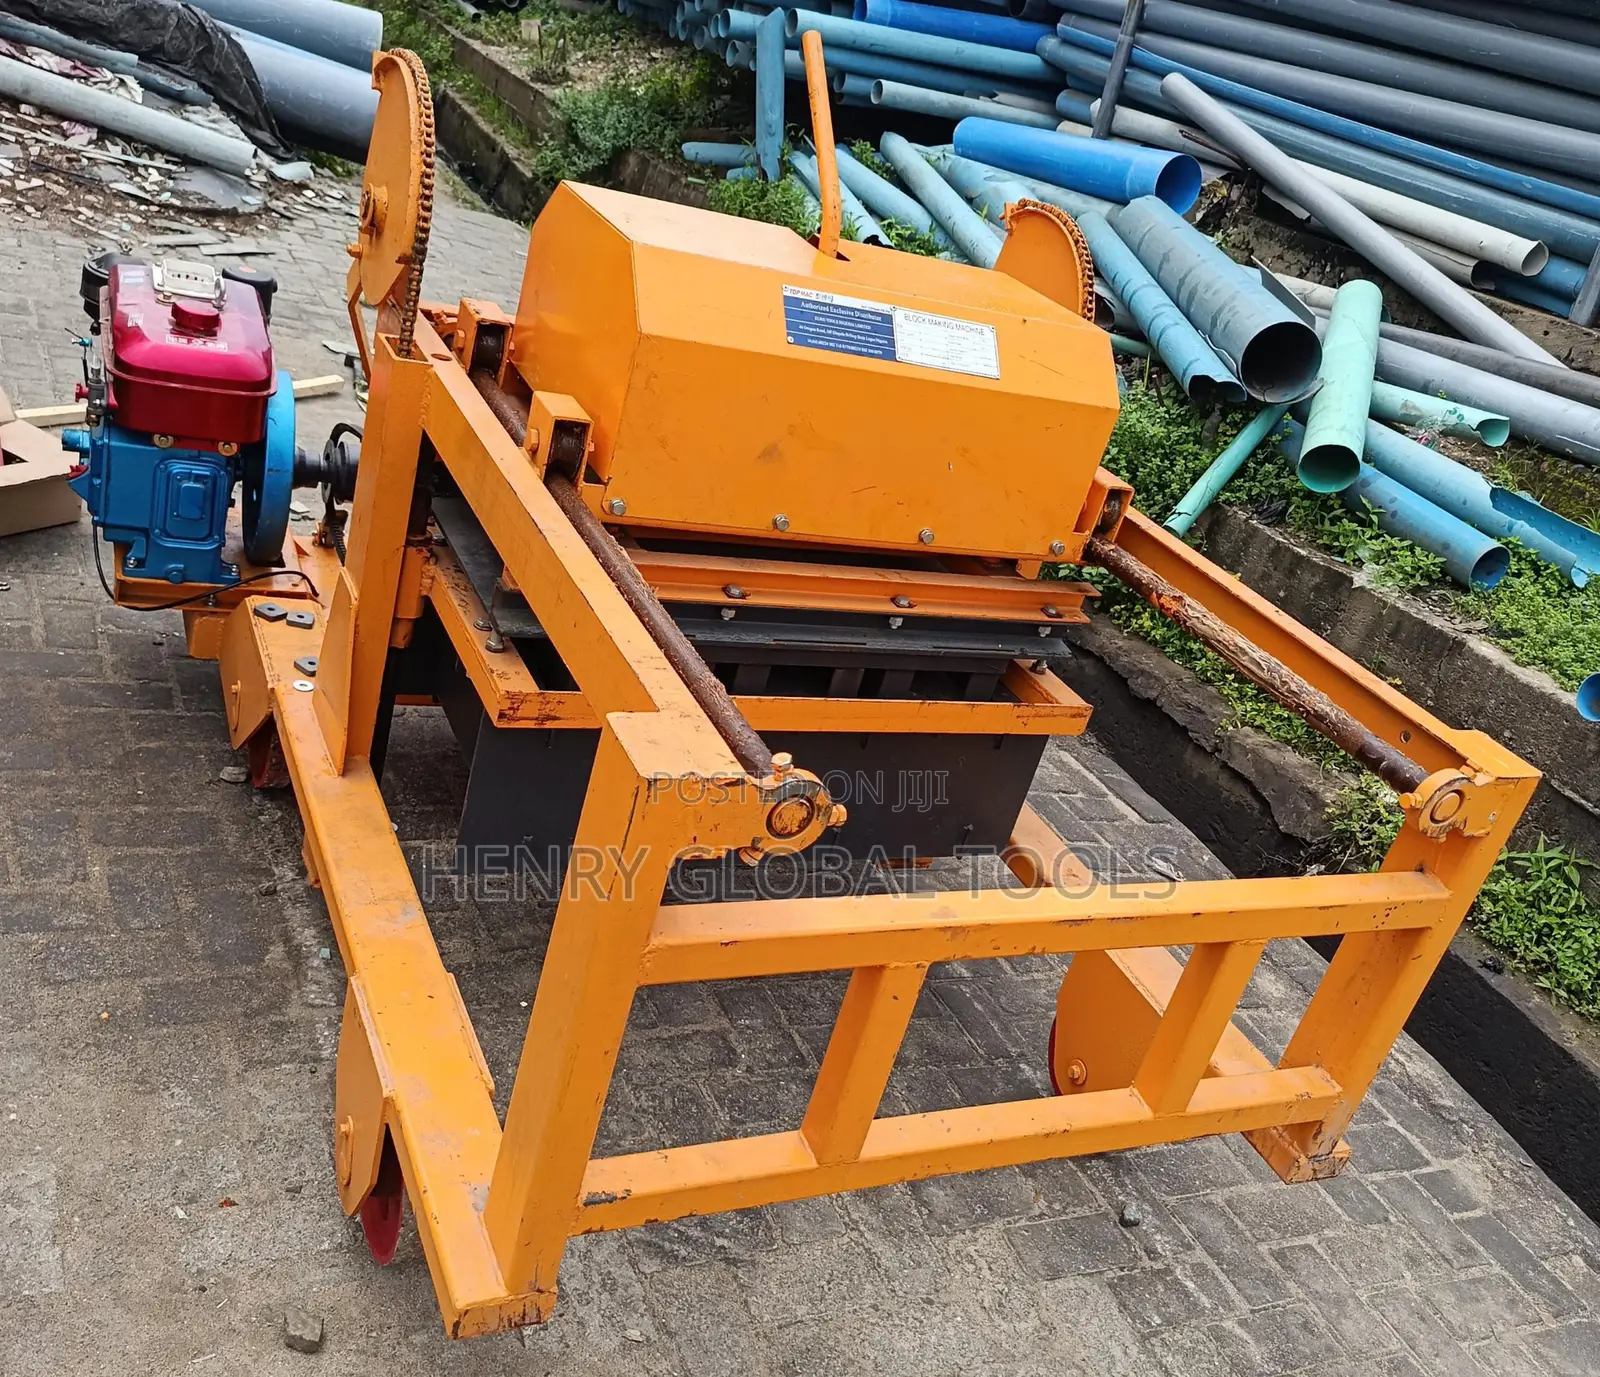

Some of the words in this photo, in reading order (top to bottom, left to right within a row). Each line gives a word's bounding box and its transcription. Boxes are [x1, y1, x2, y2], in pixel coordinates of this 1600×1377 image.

[801, 301, 829, 312] Authorized
[829, 306, 854, 317] Exclusive
[854, 310, 882, 322] Distributor
[904, 313, 927, 324] BLOCK
[927, 318, 954, 330] MAKING
[955, 323, 985, 336] MACHINE
